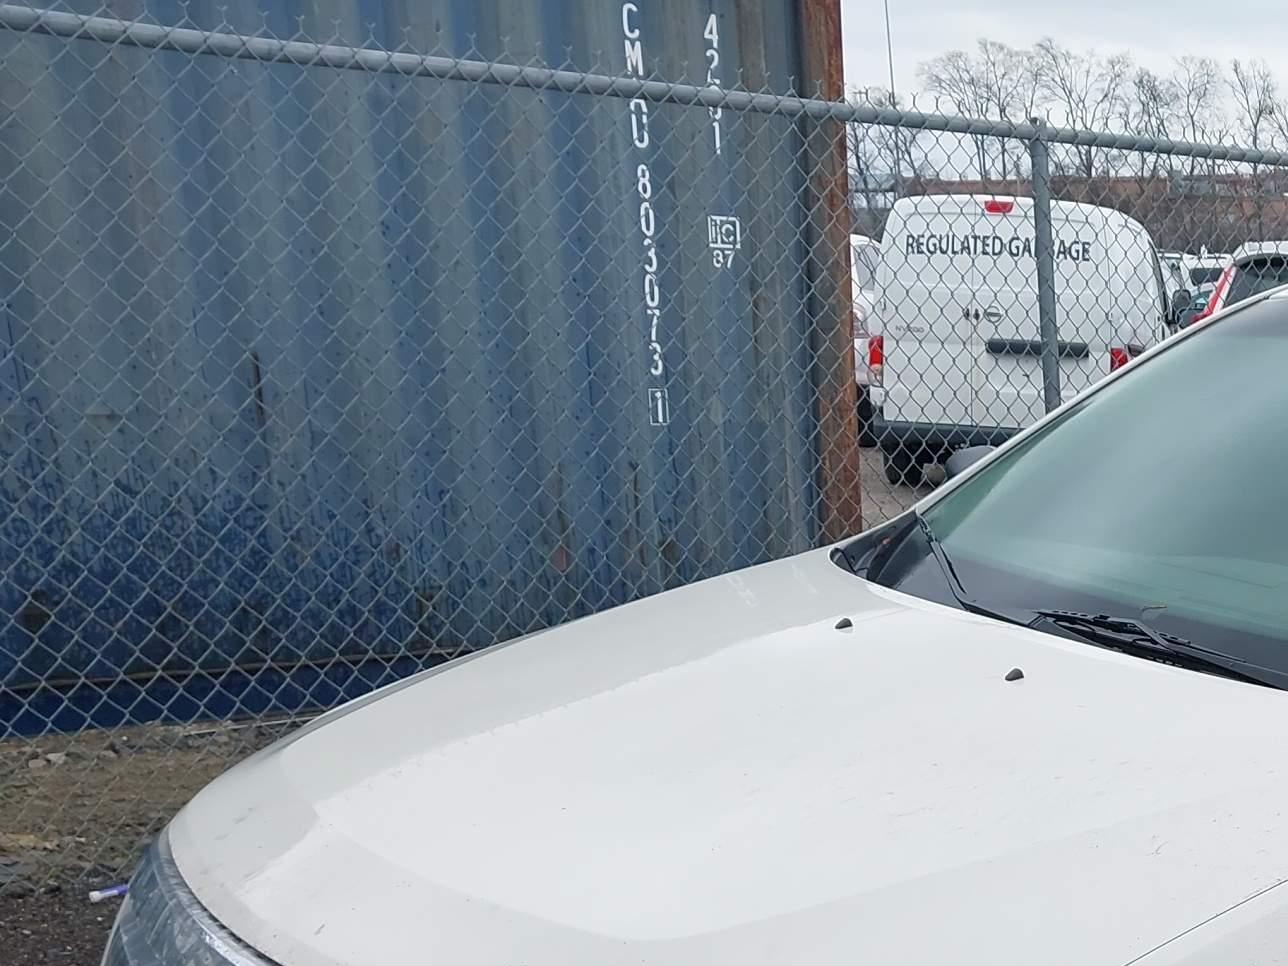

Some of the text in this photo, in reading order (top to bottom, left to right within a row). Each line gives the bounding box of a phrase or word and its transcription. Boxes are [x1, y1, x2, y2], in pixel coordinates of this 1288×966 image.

[713, 249, 735, 268] 87
[906, 233, 1092, 262] REGULATED GAAGE
[637, 164, 663, 375] 803073
